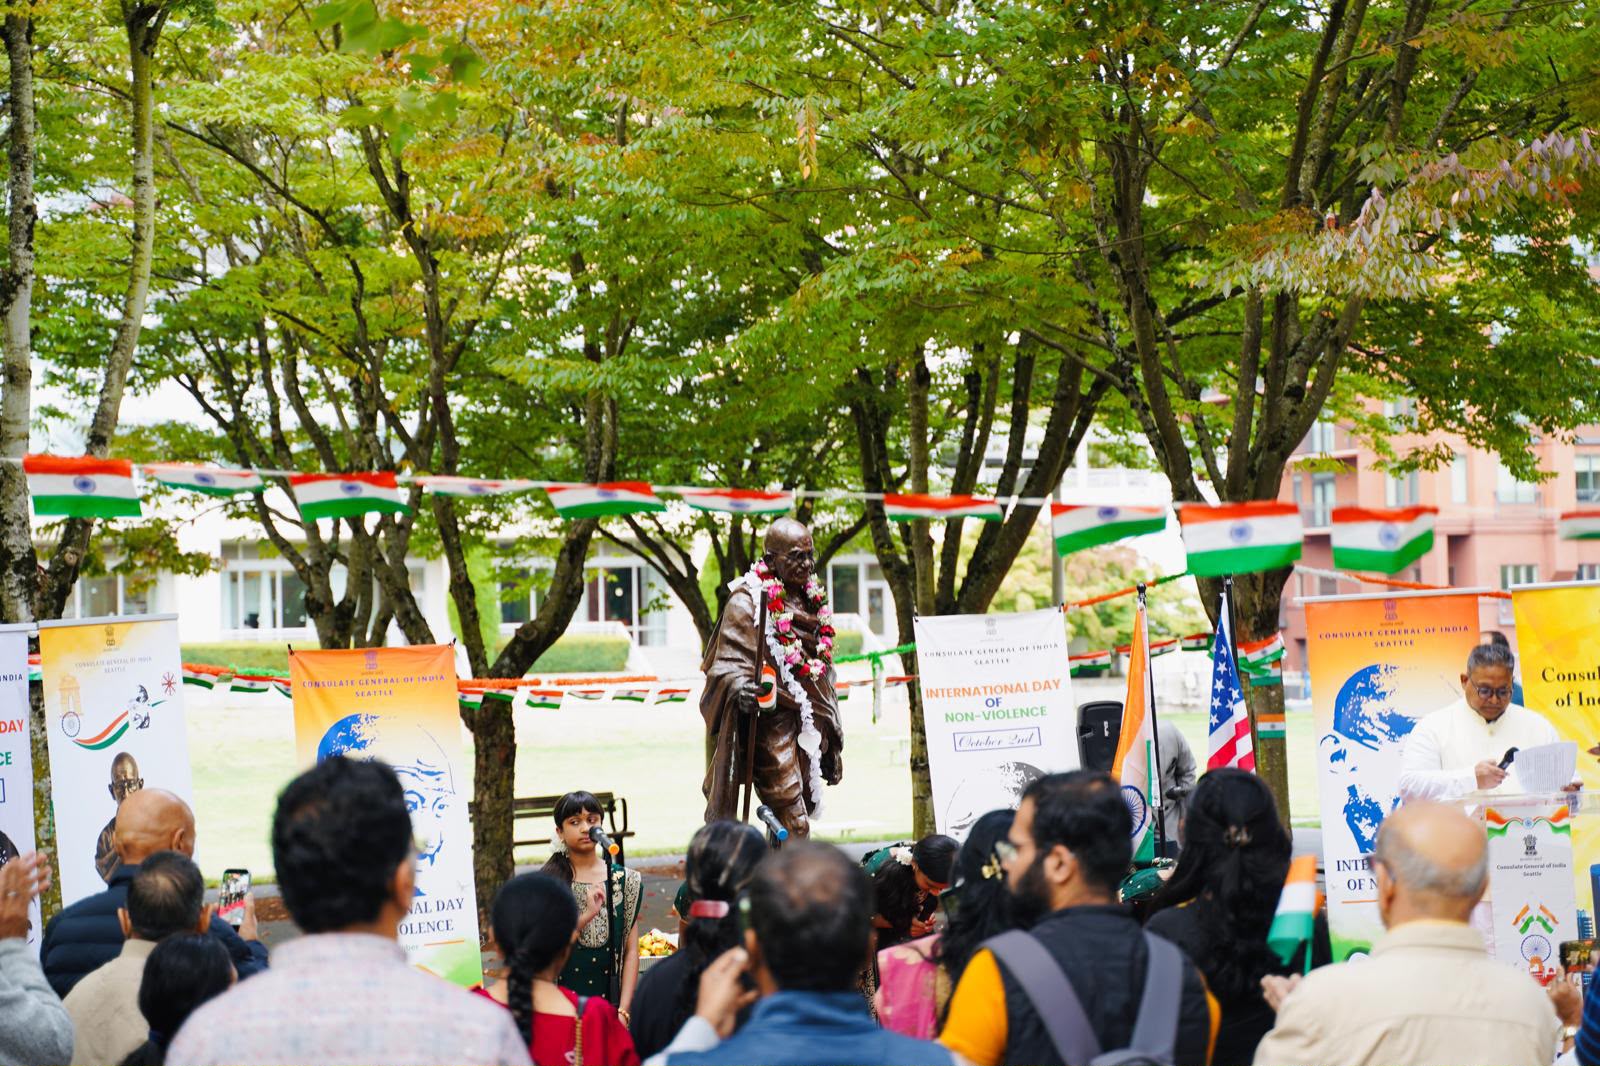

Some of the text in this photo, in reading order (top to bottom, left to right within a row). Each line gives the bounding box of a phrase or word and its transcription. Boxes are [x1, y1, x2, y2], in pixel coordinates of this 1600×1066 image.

[1319, 630, 1374, 640] CONSULATE
[1377, 628, 1421, 636] GENERAL
[1440, 625, 1469, 633] INDIA
[977, 647, 1016, 655] GENERAL
[1032, 643, 1059, 651] INDIA
[1374, 640, 1415, 648] SEATTLE
[302, 674, 445, 688] CONSULATE GENERAL OF INDIA
[355, 689, 393, 697] SEATTLE
[925, 679, 1061, 699] INTERNATIONAL DAY
[985, 697, 1002, 708] OF
[1556, 691, 1573, 706] of
[944, 705, 1048, 723] NON-VIOLENCE
[0, 719, 24, 734] DAY
[958, 731, 1035, 748] October 2nd
[1347, 878, 1366, 891] OF
[436, 897, 465, 912] DAY
